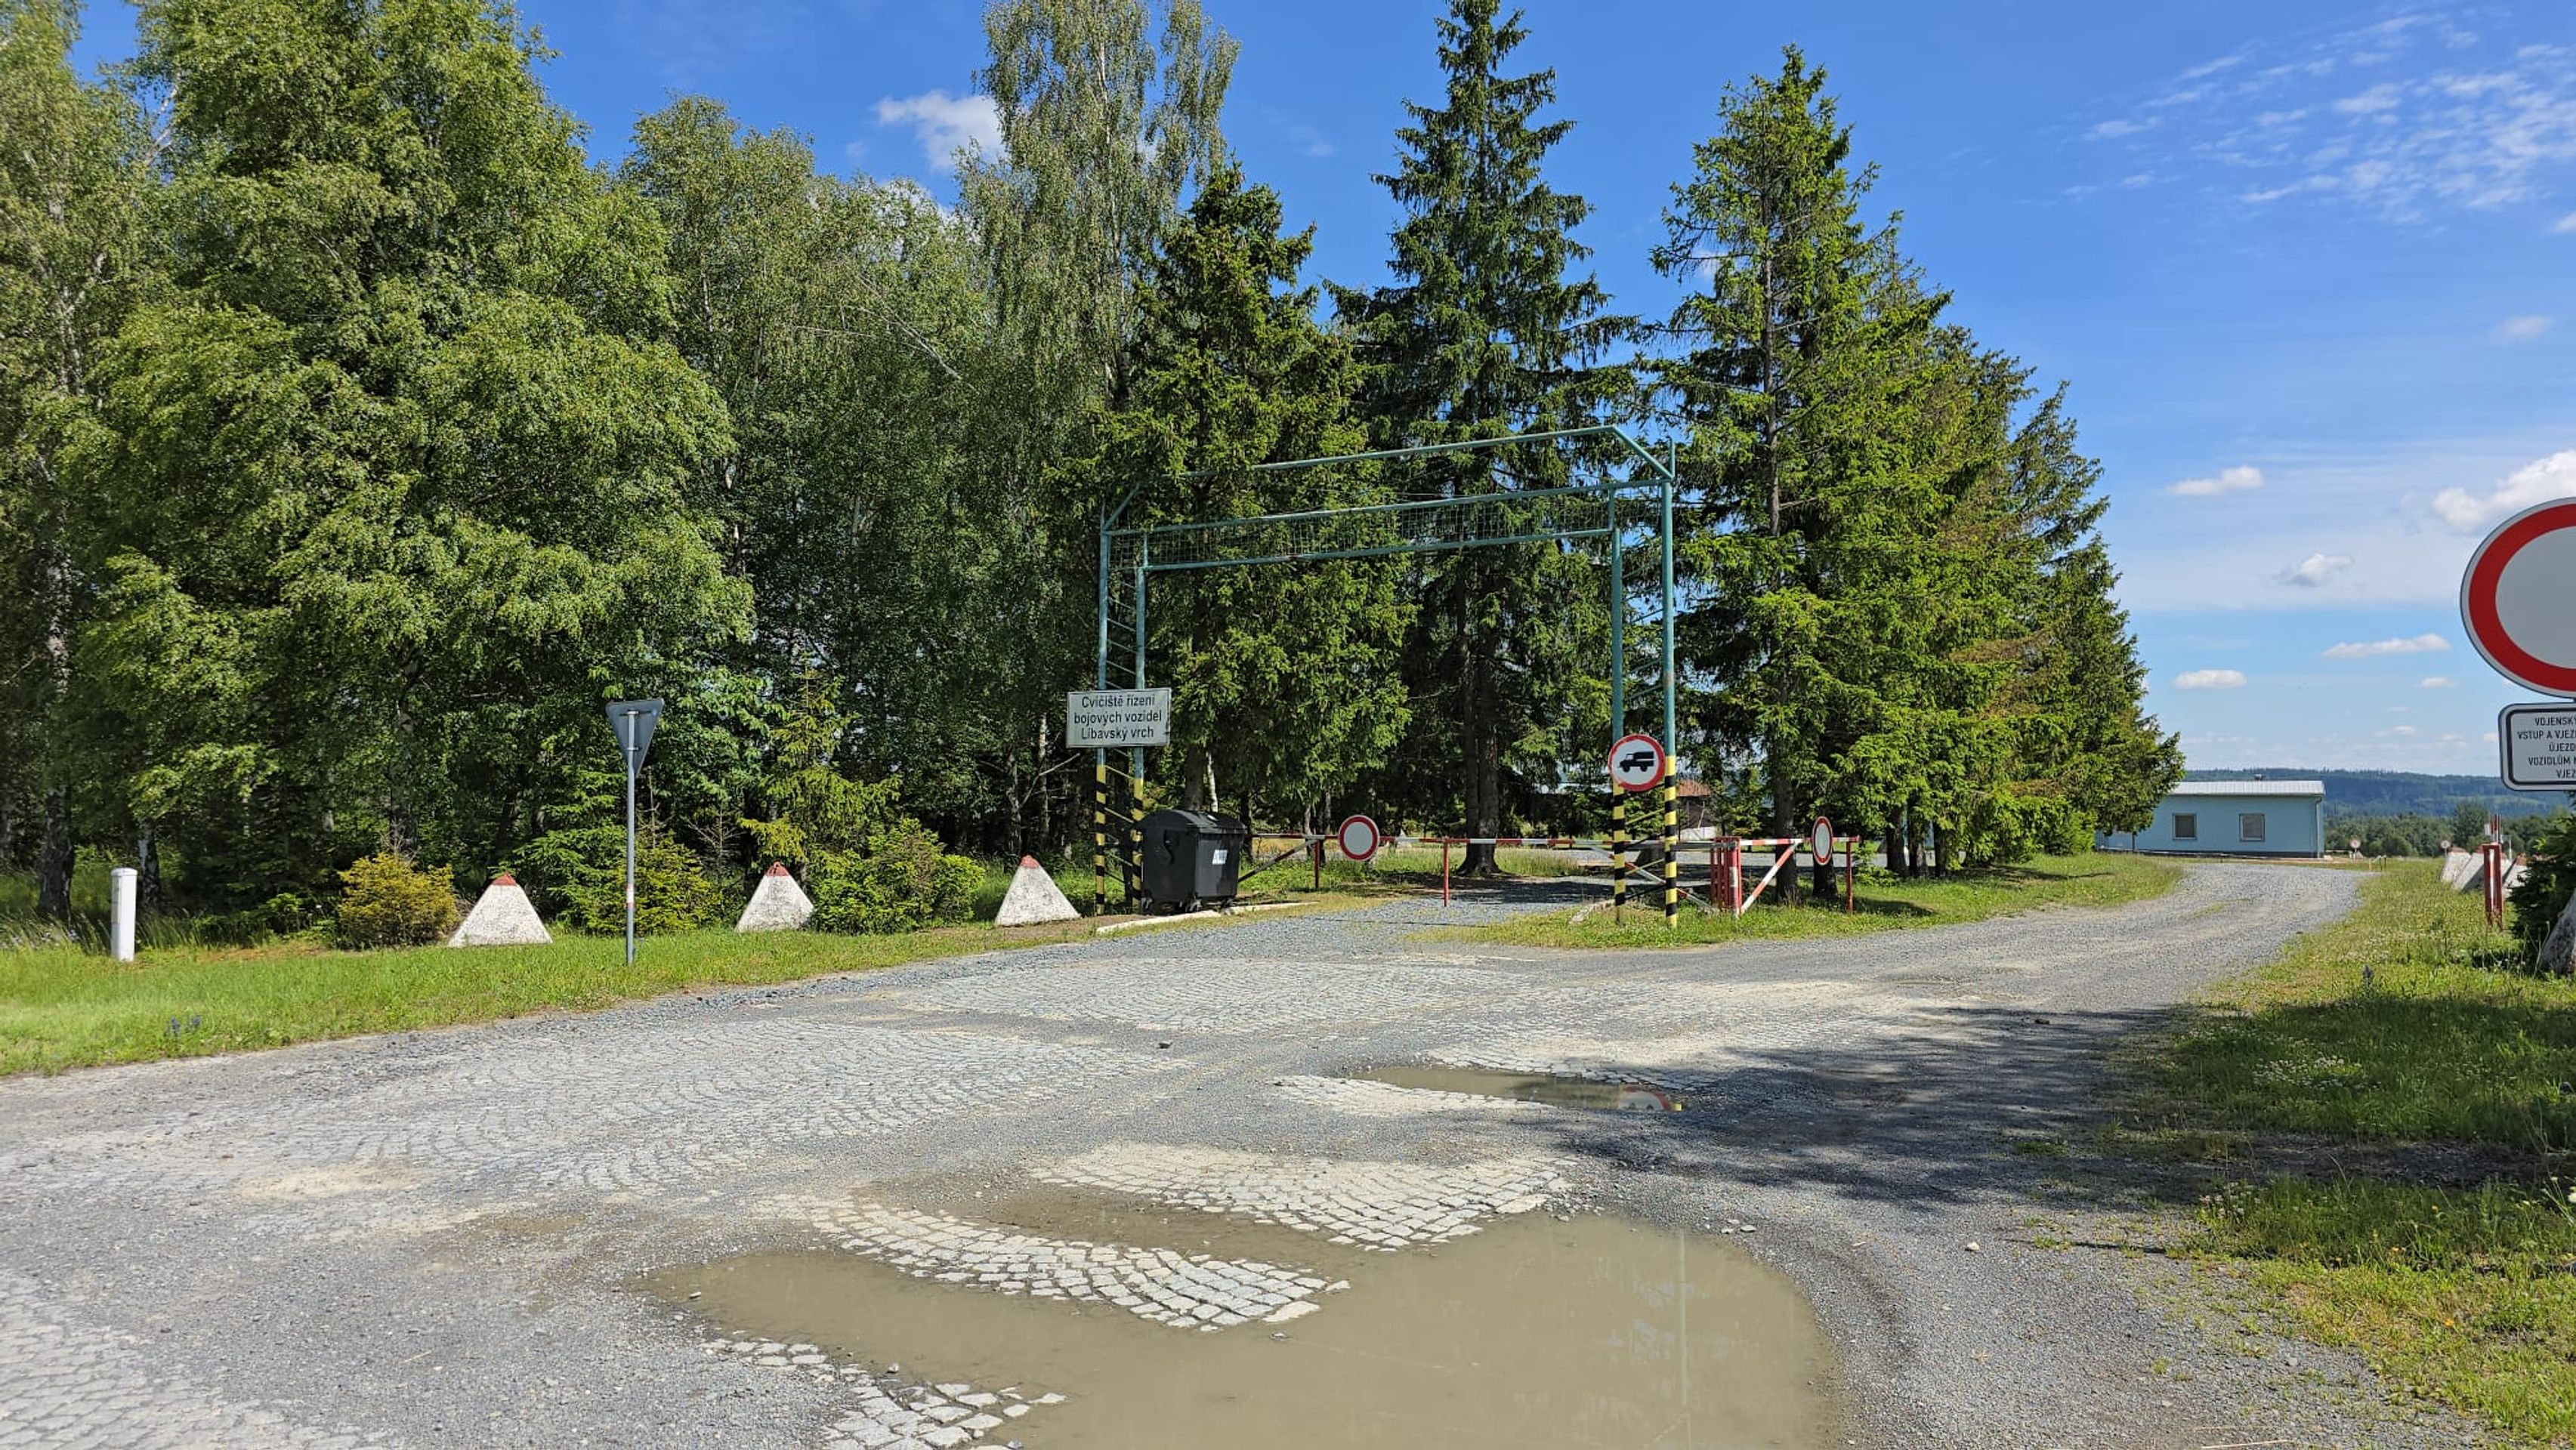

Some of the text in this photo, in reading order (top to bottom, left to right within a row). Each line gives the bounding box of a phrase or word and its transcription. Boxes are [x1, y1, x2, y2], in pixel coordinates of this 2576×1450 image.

[1074, 710, 1162, 727] bojových vozidel
[1131, 726, 1154, 738] vrch
[2517, 730, 2576, 739] VSTUP A VJEZ
[2528, 755, 2571, 766] VOZIDLŮM
